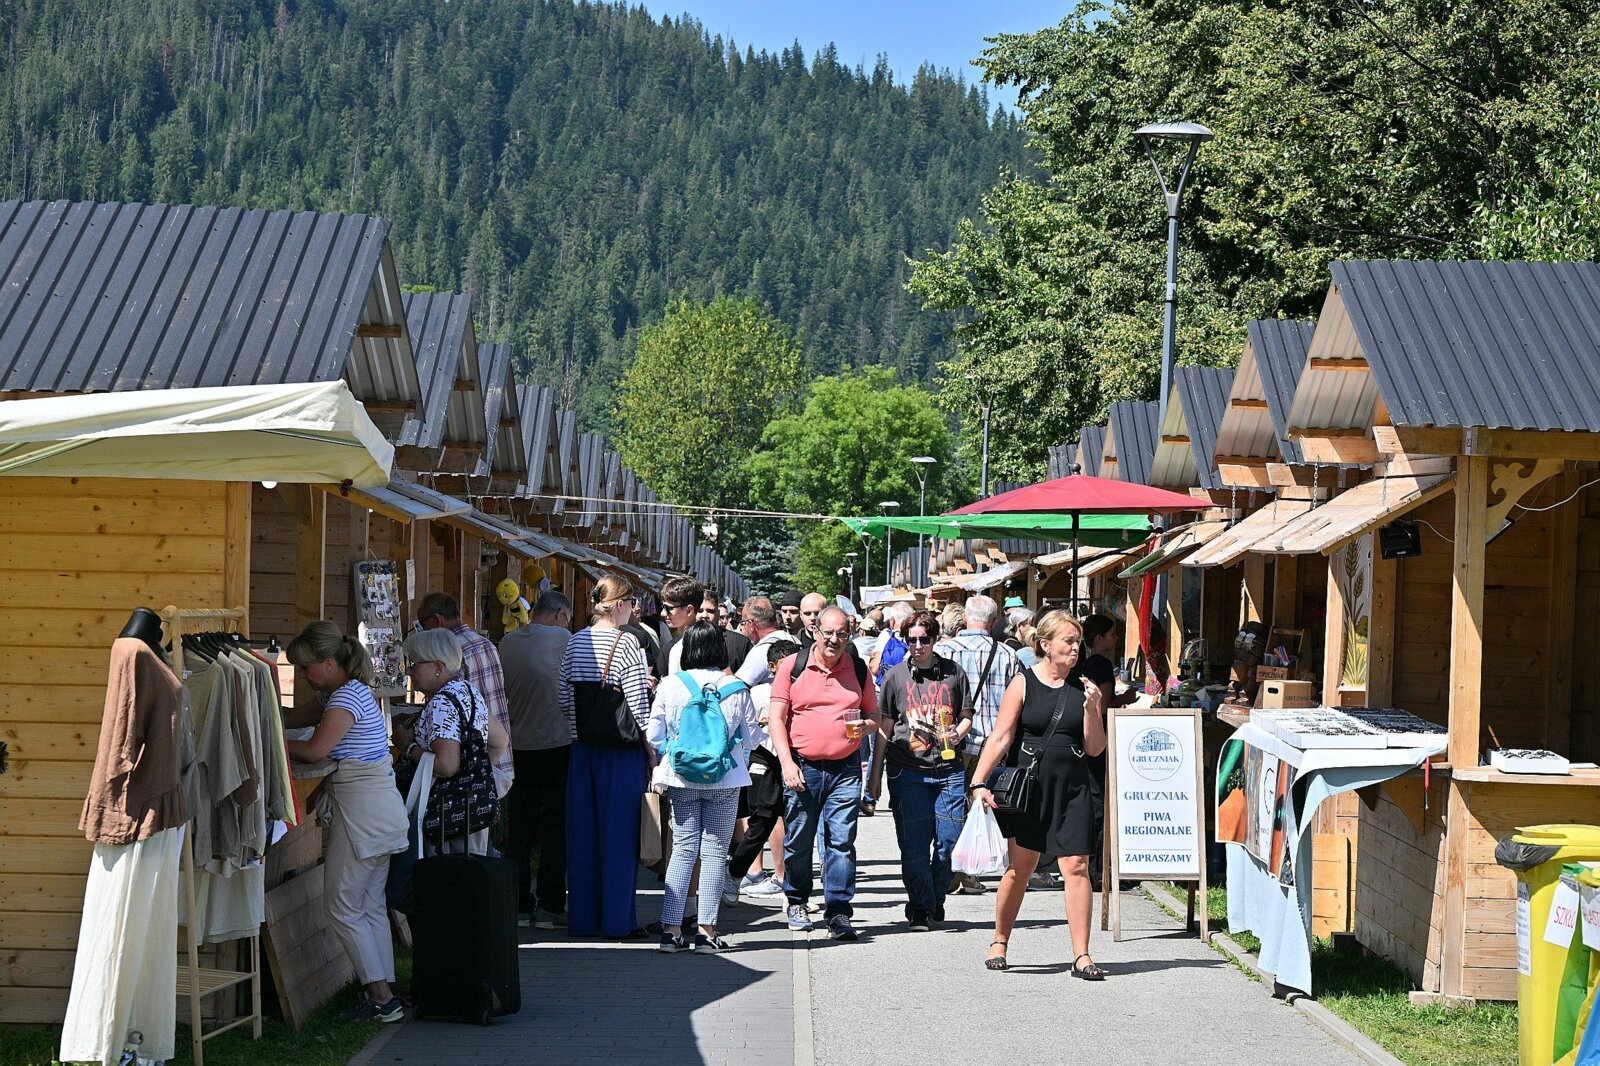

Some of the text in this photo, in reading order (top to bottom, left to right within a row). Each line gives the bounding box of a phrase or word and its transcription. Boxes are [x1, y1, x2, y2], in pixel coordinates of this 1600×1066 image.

[1124, 791, 1188, 801] GRUCZNIAK
[1144, 812, 1172, 822] PIWA
[1124, 826, 1192, 835] REGIONALNE
[1125, 854, 1192, 862] ZAPRASZAMY
